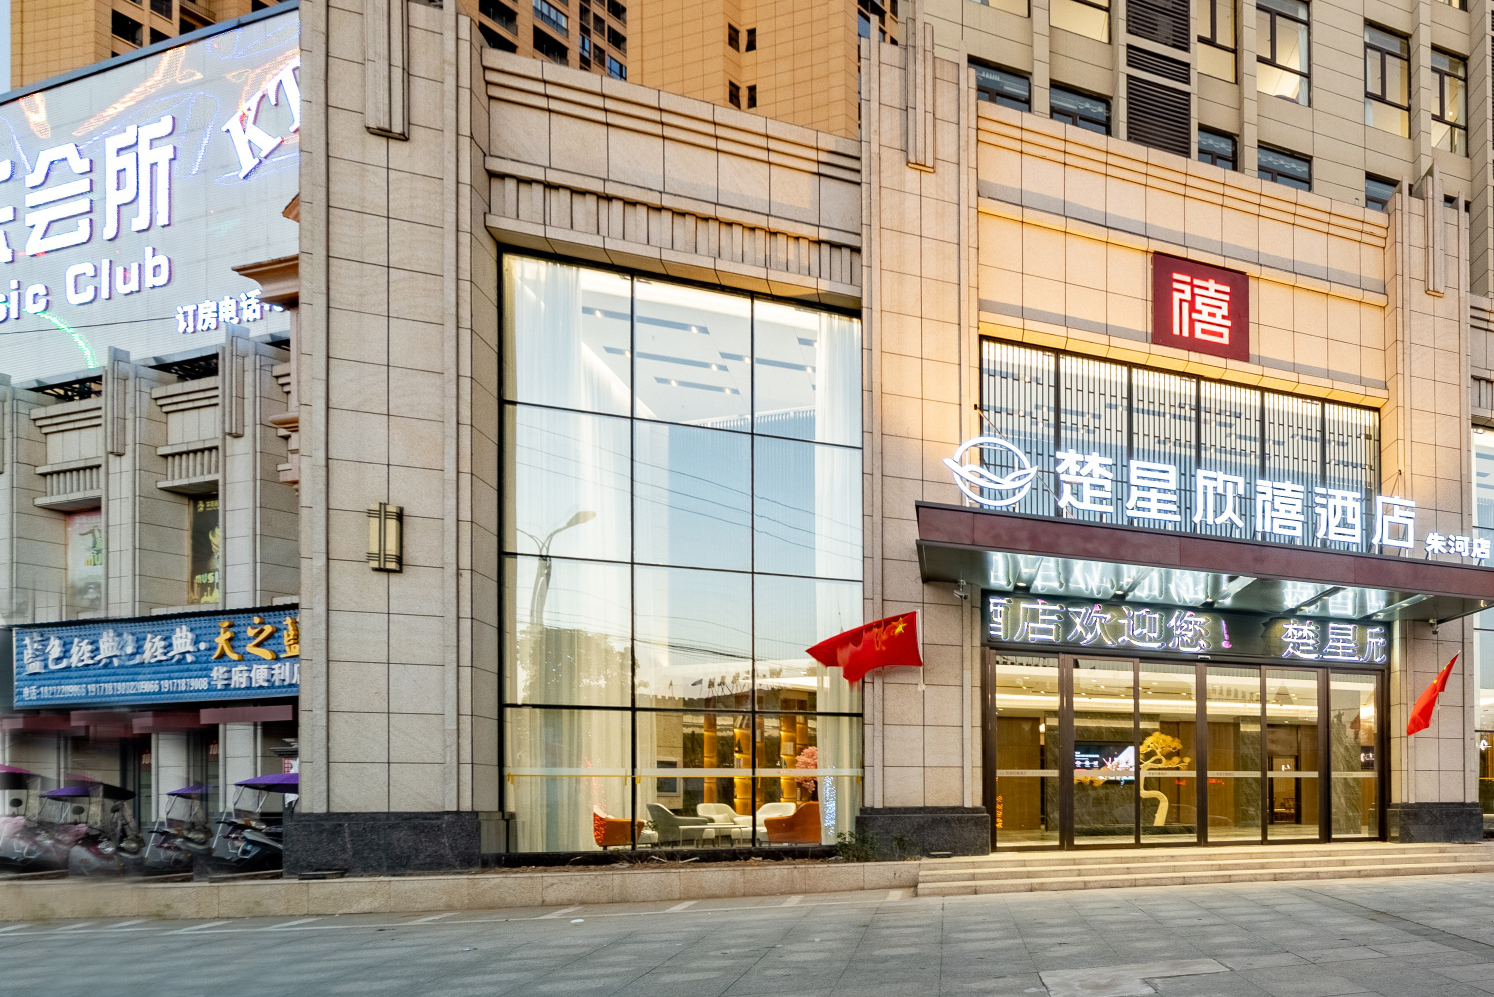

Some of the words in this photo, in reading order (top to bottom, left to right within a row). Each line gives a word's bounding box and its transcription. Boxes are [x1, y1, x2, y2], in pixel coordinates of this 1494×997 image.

[65, 246, 172, 306] Club
[1172, 272, 1232, 345] 禧
[1055, 448, 1416, 550] 楚星欣禧酒店
[1425, 531, 1491, 560] 朱河店
